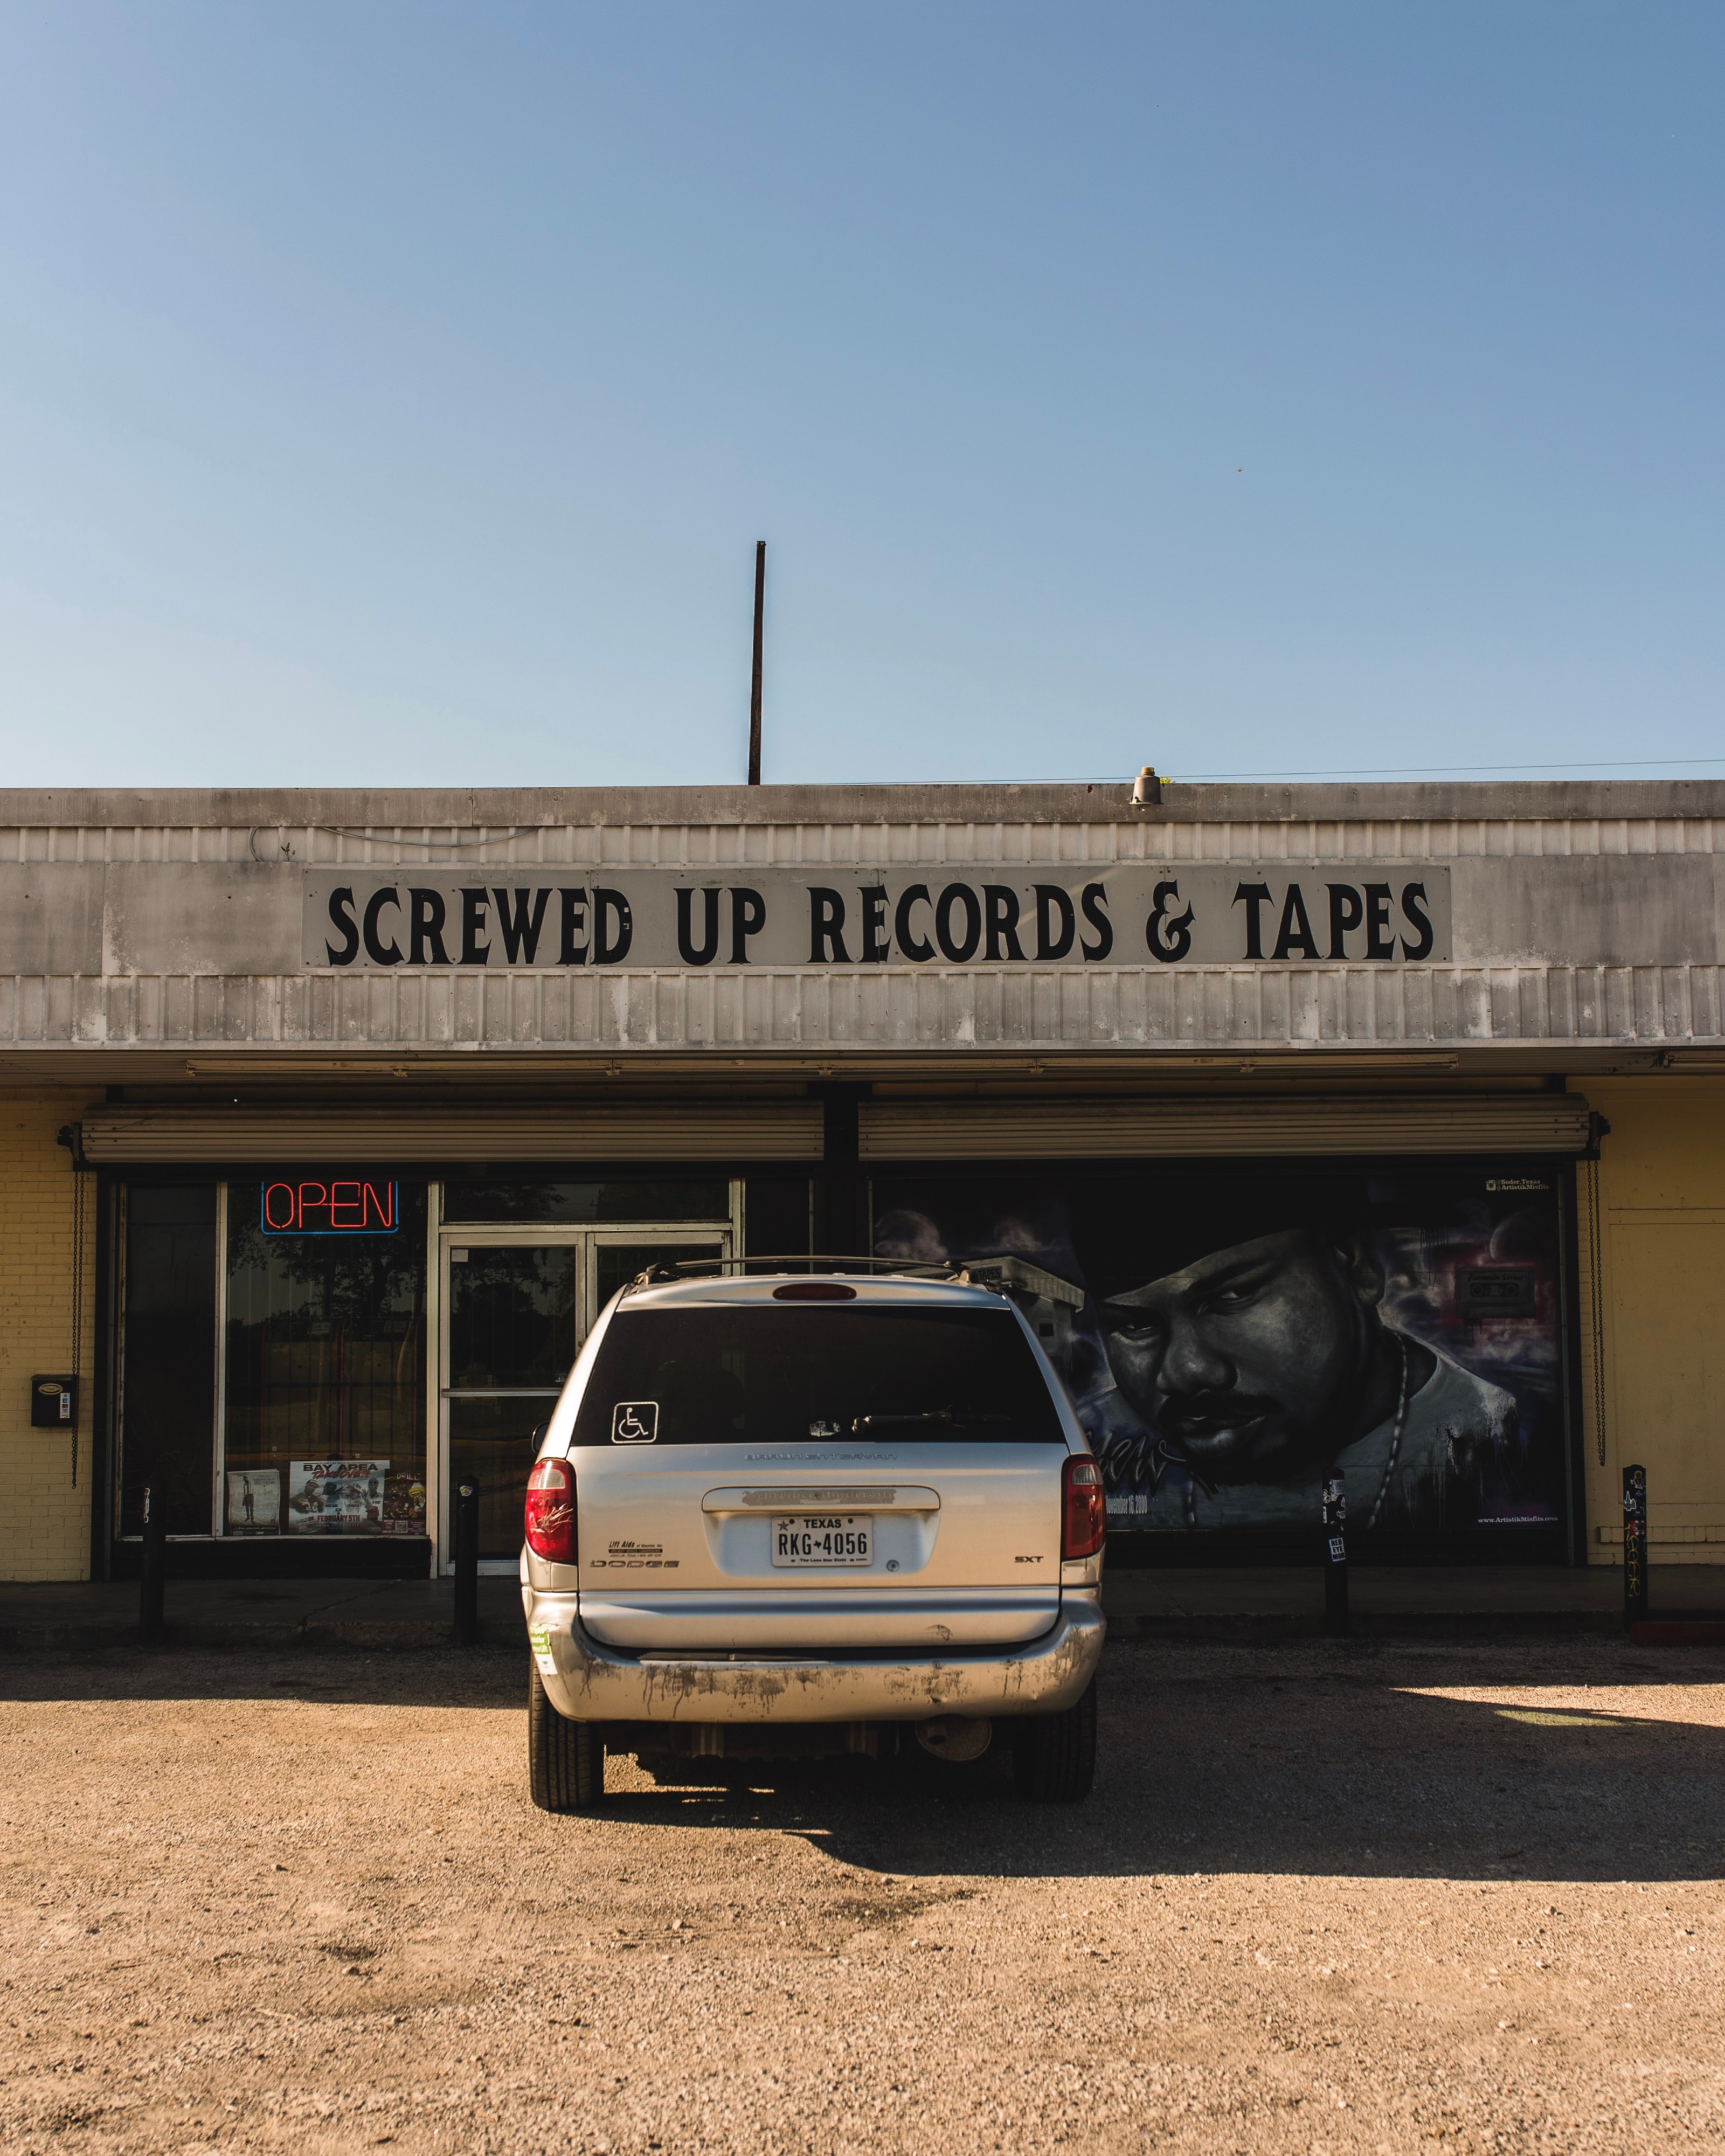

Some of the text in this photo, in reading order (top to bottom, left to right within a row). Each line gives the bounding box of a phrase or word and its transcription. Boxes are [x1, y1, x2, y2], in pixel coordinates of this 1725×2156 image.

[325, 879, 1433, 966] SCREWED UP RECORDS & TAPES
[266, 1182, 392, 1228] OPEN
[311, 1470, 371, 1479] TAKEOVER
[397, 1472, 419, 1481] DRILL
[1135, 1495, 1147, 1514] 2000
[803, 1519, 842, 1529] TEXAS
[621, 1540, 635, 1548] Aids
[590, 1560, 680, 1568] DODGE
